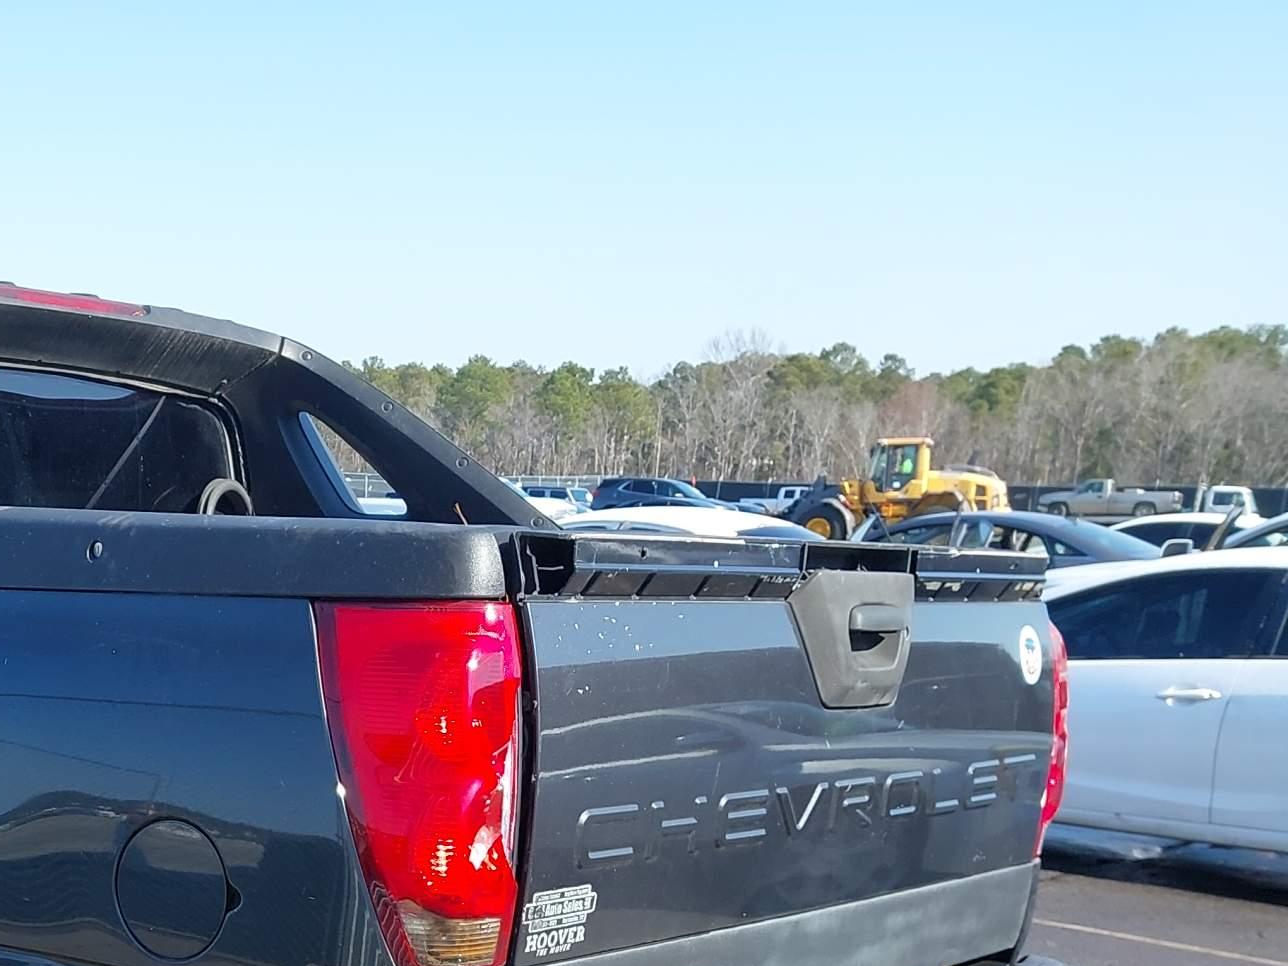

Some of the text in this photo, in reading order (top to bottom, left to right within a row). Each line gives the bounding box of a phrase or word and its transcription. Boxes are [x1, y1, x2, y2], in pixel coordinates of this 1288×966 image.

[576, 753, 1037, 870] CHEVROLET
[524, 925, 585, 953] HOOVER
[535, 948, 548, 957] THE
